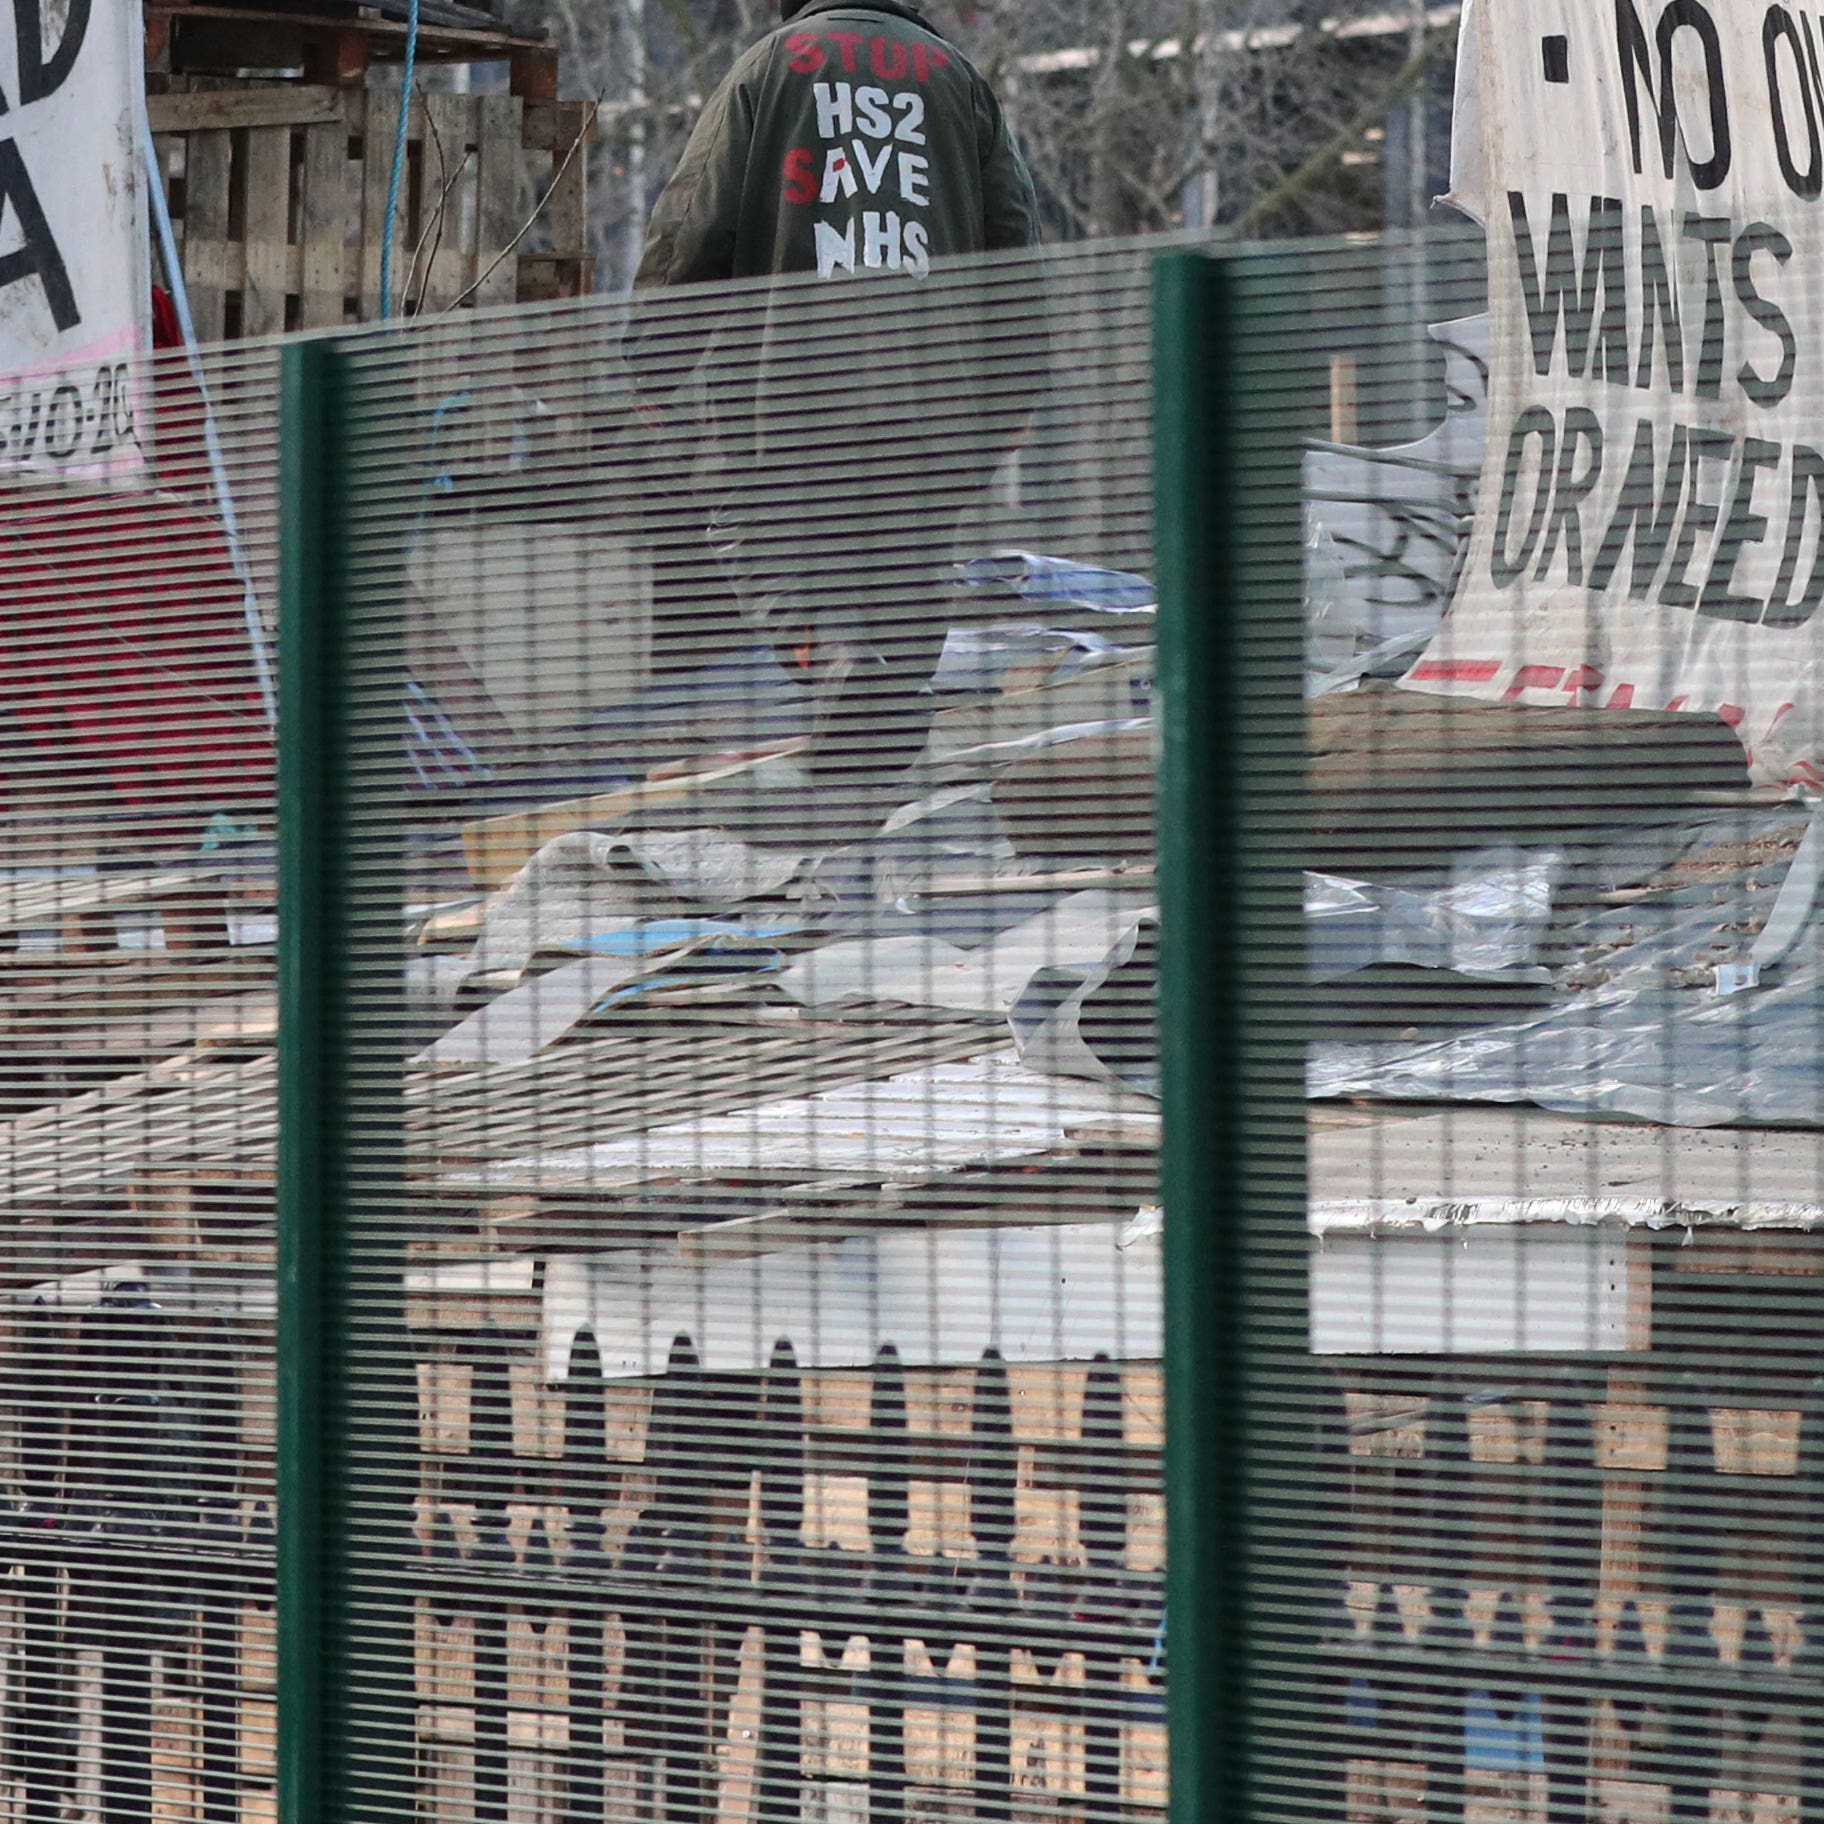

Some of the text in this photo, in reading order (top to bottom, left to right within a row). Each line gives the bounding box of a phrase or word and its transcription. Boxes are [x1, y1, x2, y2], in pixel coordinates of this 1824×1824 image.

[813, 81, 927, 146] HS2
[782, 138, 930, 207] SAVE
[813, 210, 930, 281] NHS
[1507, 190, 1797, 410] WANTS
[1490, 404, 1604, 589] OR
